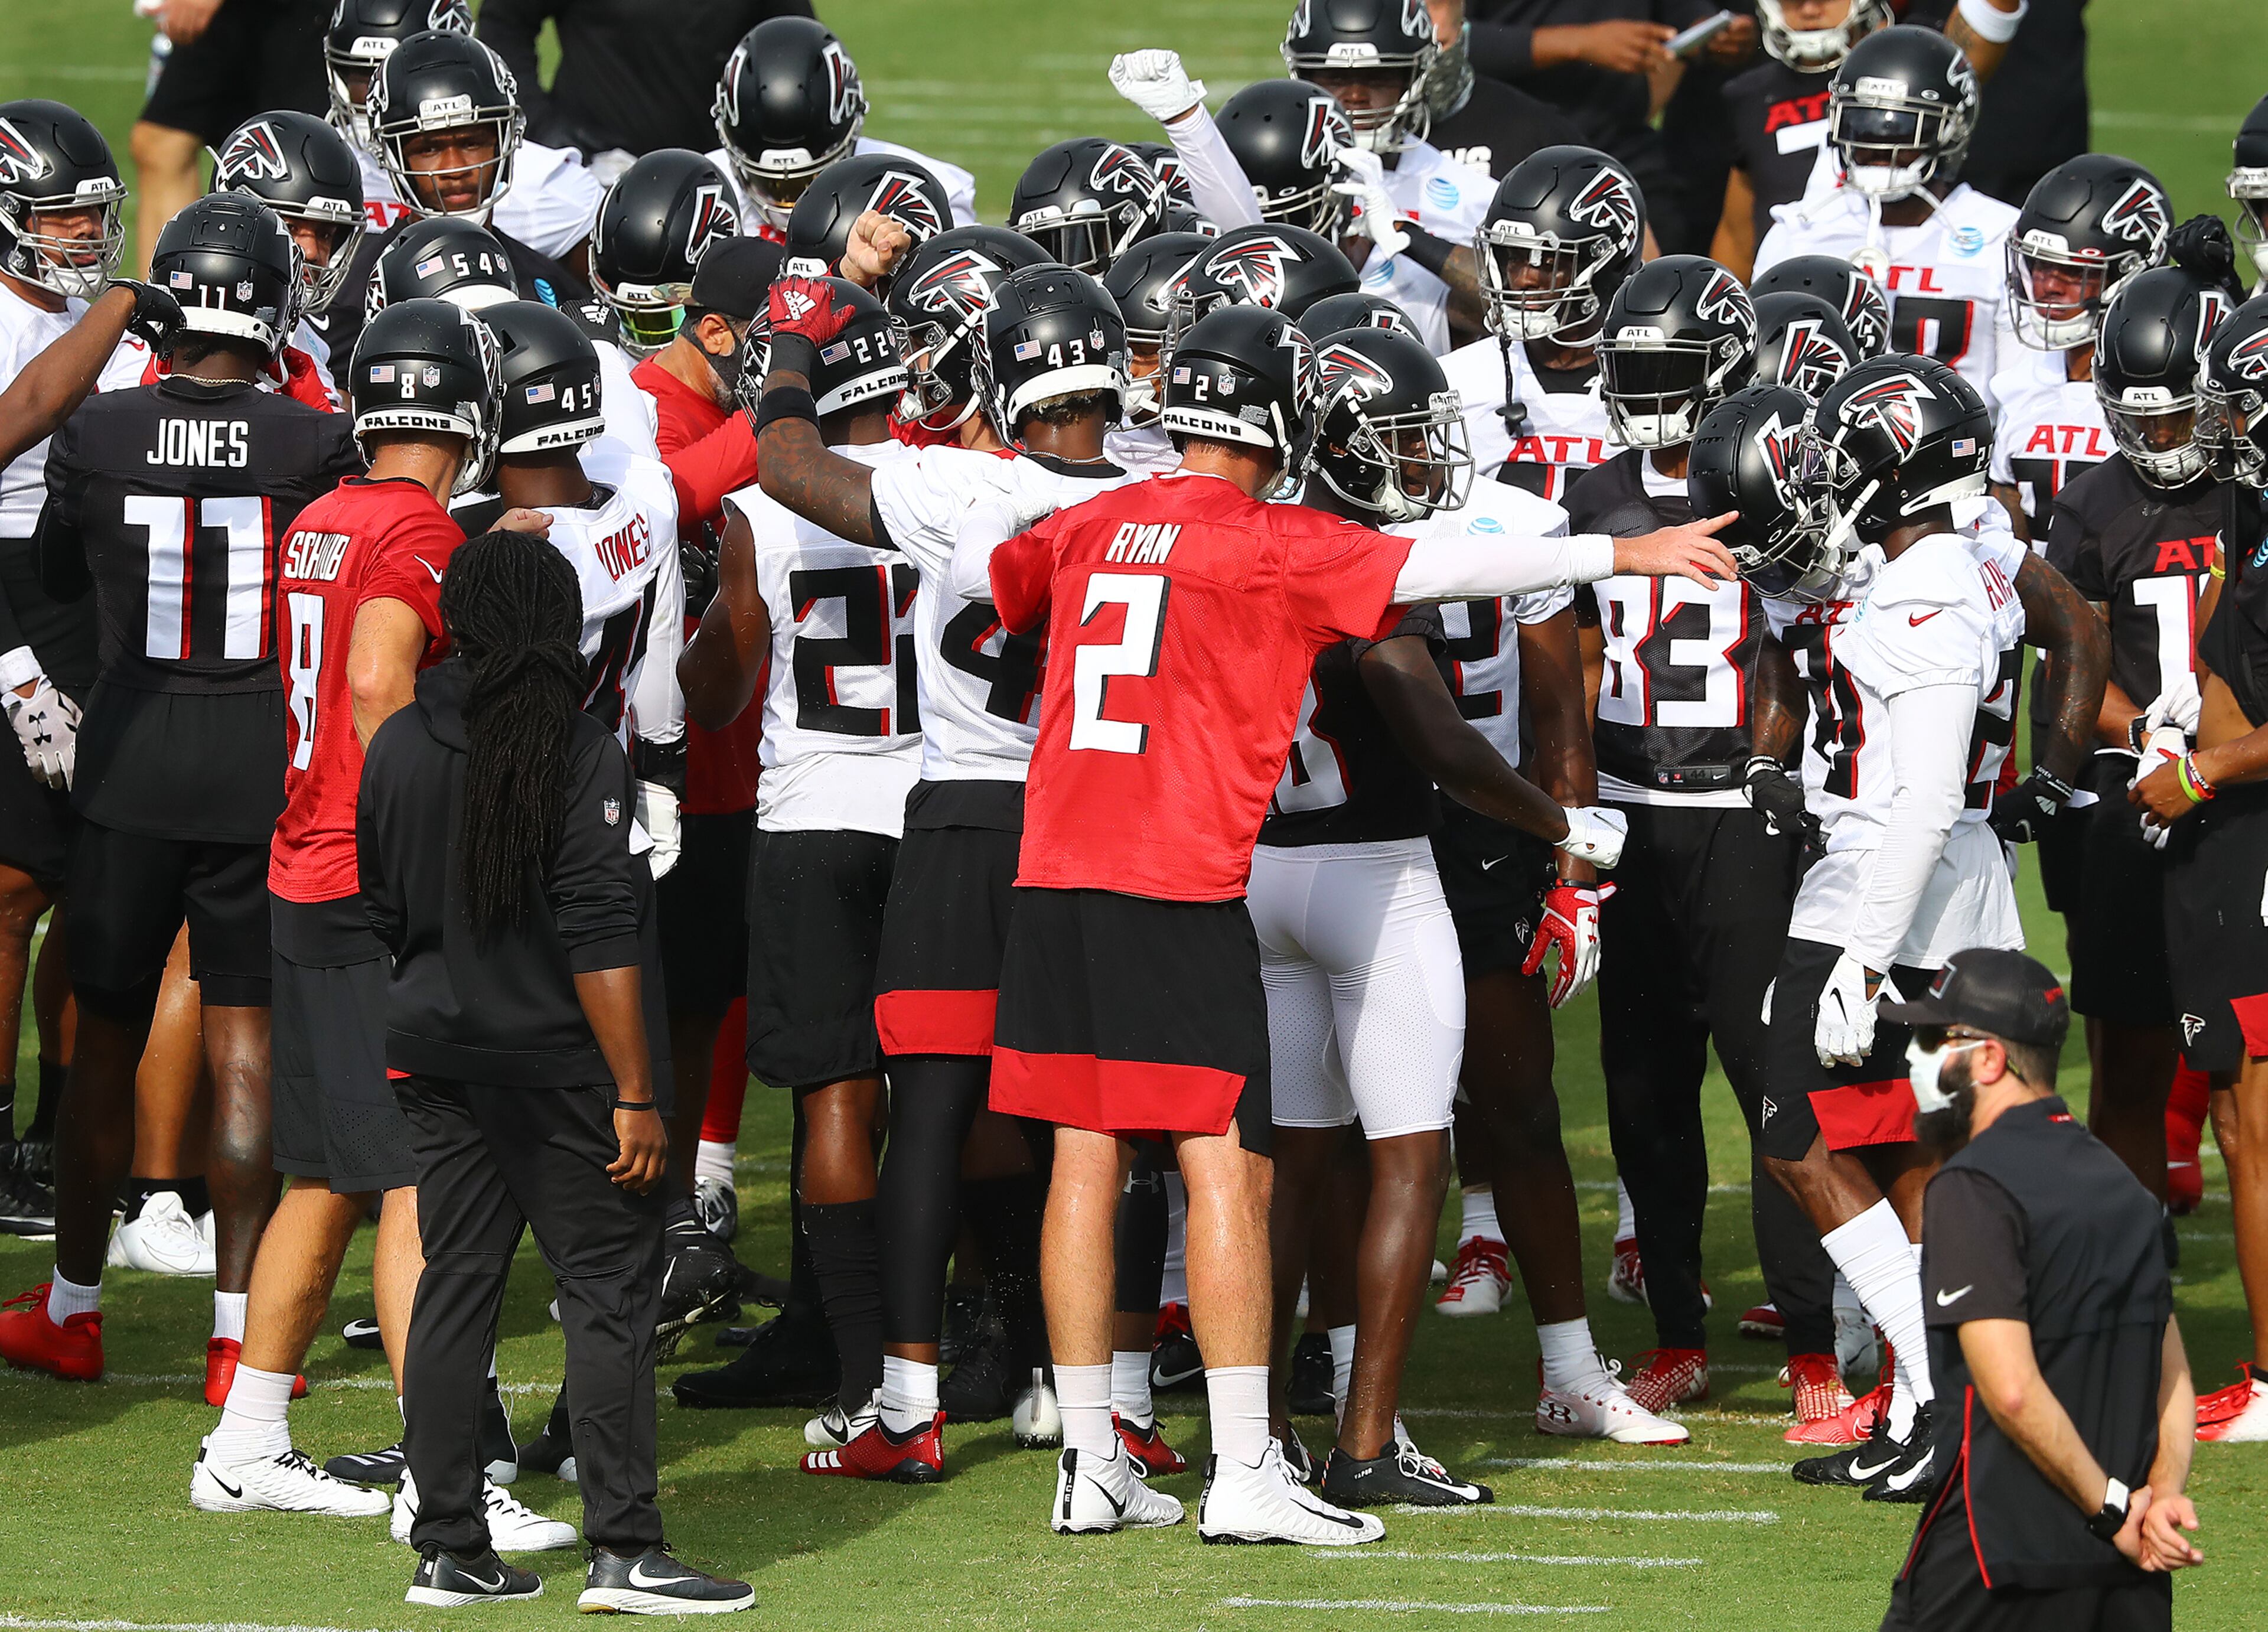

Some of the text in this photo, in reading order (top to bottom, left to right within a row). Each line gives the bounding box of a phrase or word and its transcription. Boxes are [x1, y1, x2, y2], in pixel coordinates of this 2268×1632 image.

[361, 41, 387, 50] ATL
[432, 102, 460, 113] ATL
[772, 157, 798, 166] ATL
[90, 182, 110, 192] ATL
[322, 201, 345, 212] ATL
[1027, 211, 1047, 224] ATL
[1500, 224, 1520, 235] ATL
[2032, 235, 2054, 247] ATL
[451, 253, 493, 278] 54
[792, 263, 813, 272] ATL
[198, 284, 226, 310] 11
[1626, 328, 1650, 337] ATL
[853, 332, 889, 364] 22
[1047, 339, 1086, 368] 43
[395, 373, 416, 399] 8
[561, 383, 591, 413] 45
[840, 373, 910, 402] FALCONS
[1195, 374, 1210, 401] 2
[2133, 393, 2159, 401] ATL
[364, 416, 451, 430] FALCONS
[537, 424, 605, 447] FALCONS
[1164, 413, 1241, 437] FALCONS
[146, 418, 249, 468] JONES
[1506, 436, 1608, 464] ATL
[2025, 425, 2109, 457] ATL
[1104, 522, 1182, 565] RYAN
[123, 495, 272, 659] 11
[1592, 575, 1749, 726] 83
[1068, 572, 1171, 755] 2
[288, 591, 325, 772] 8
[1354, 1467, 1373, 1480] VAPOR
[1064, 1474, 1073, 1503] ICE
